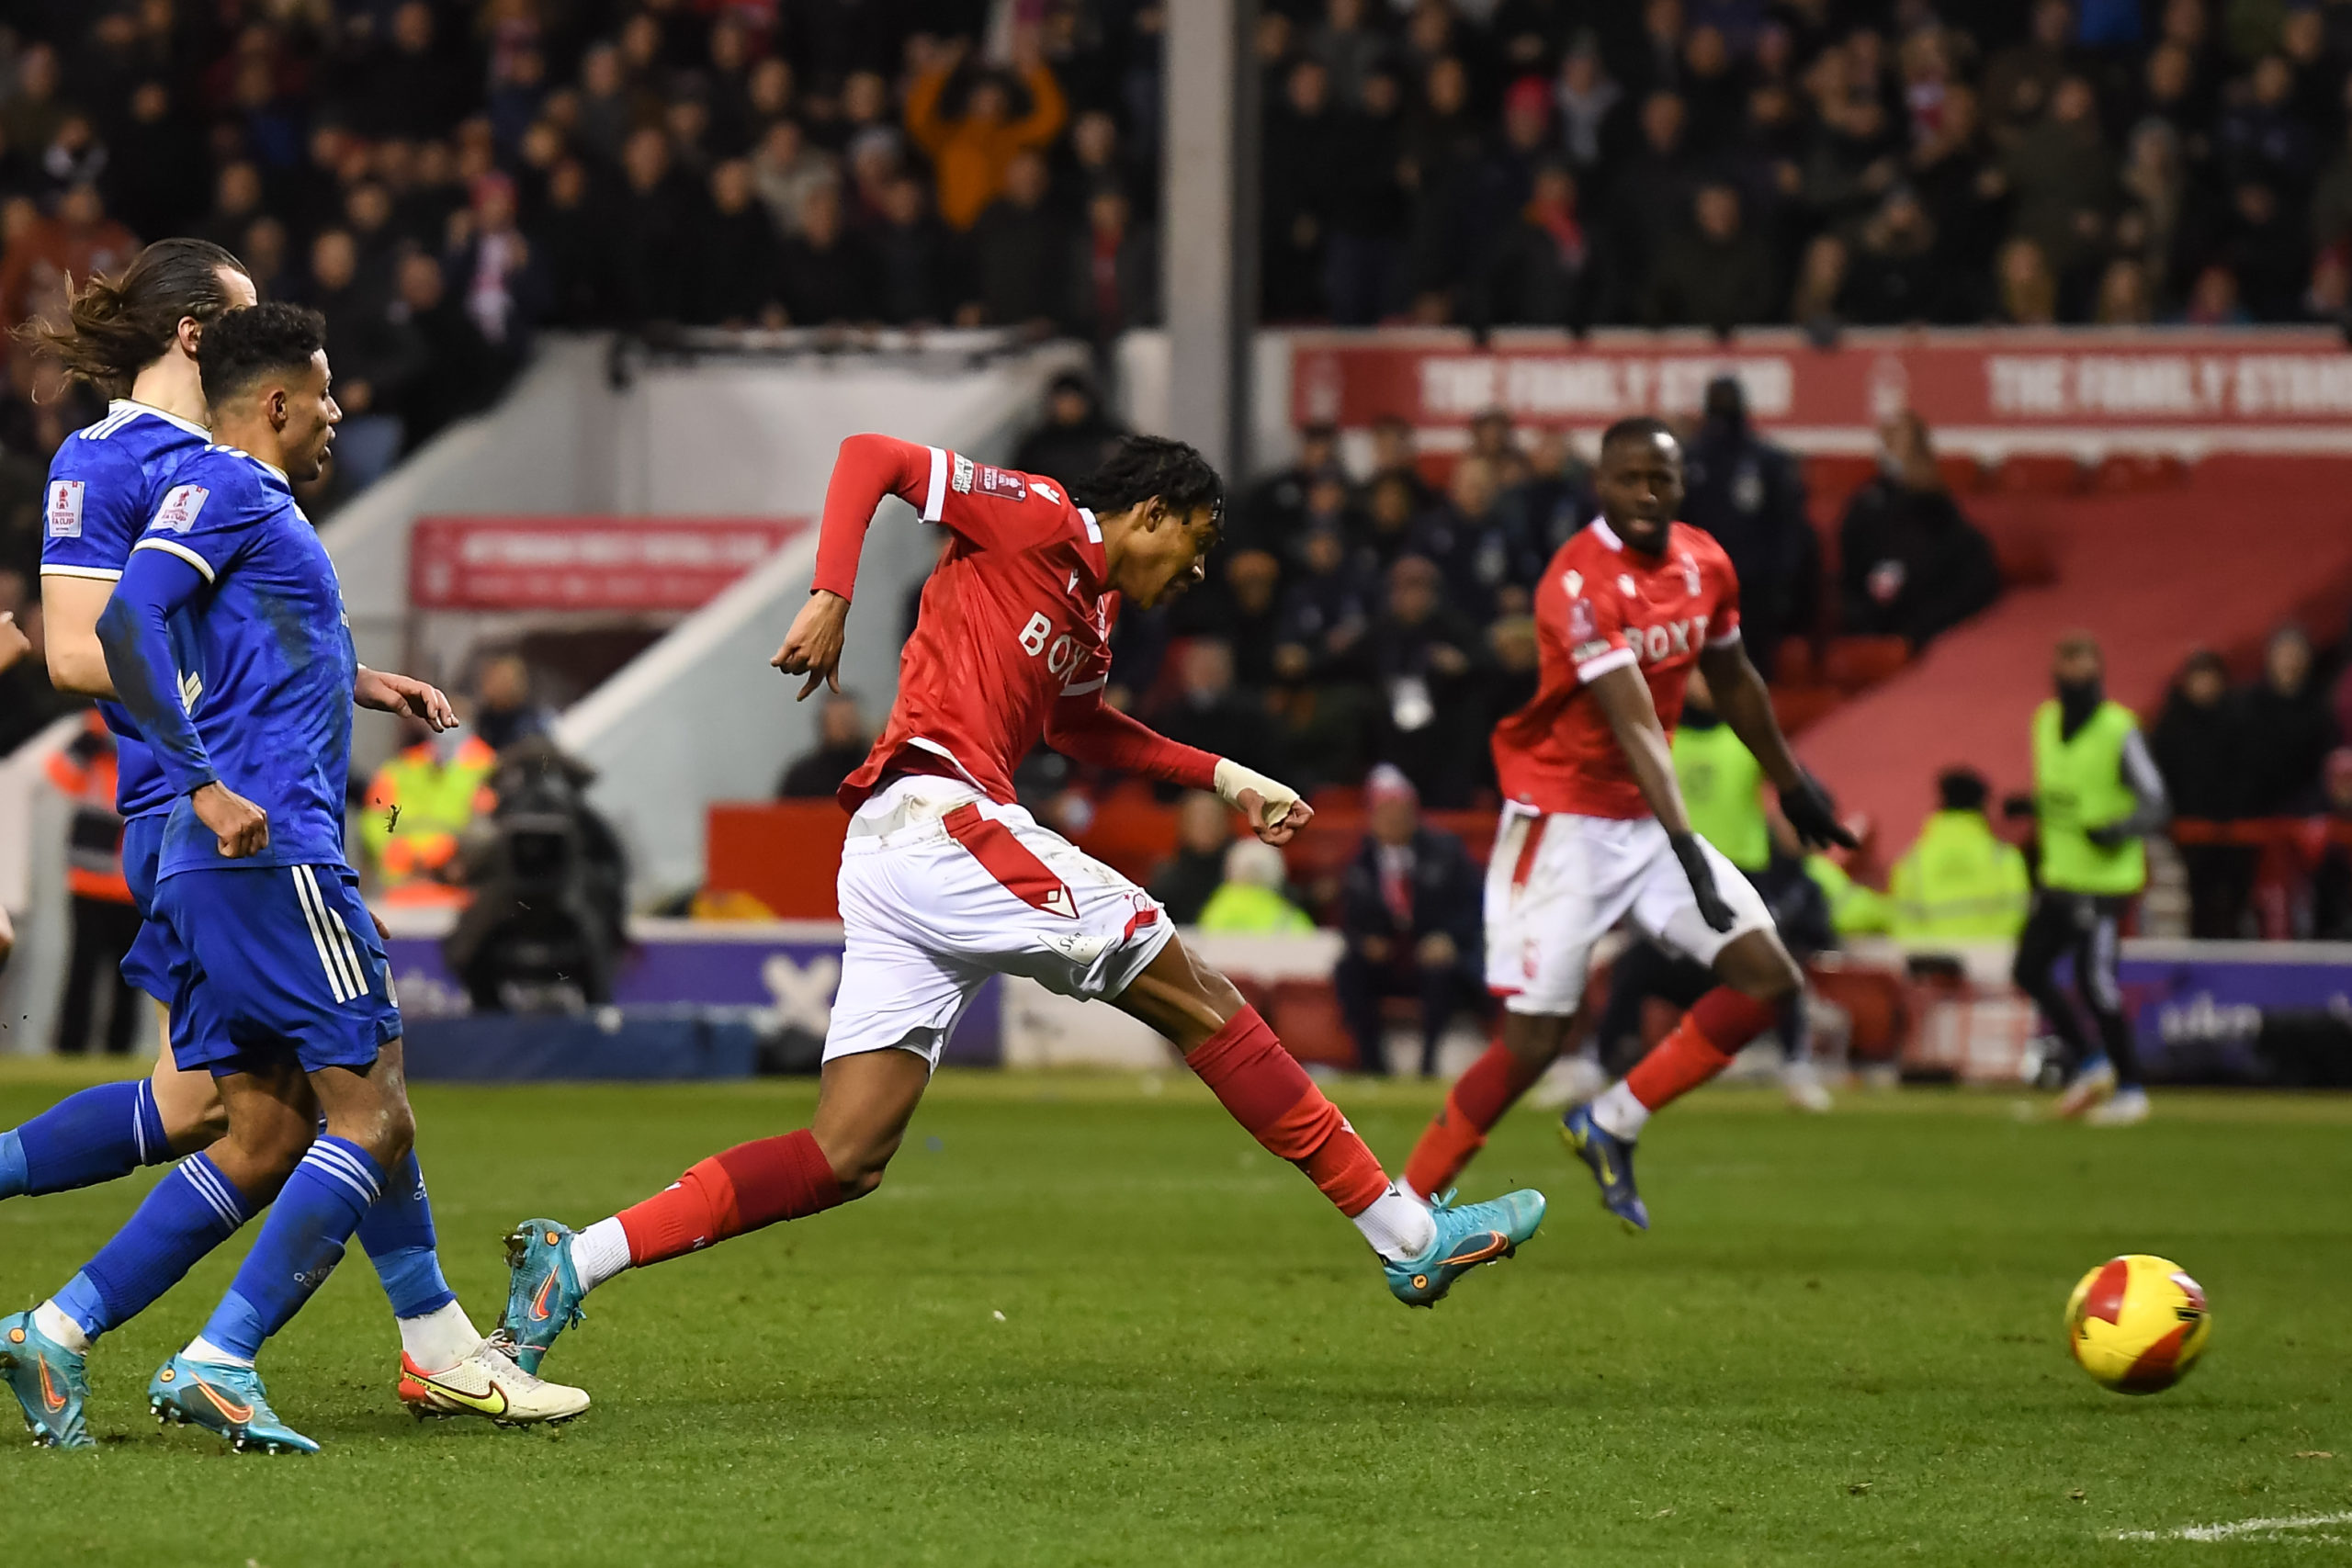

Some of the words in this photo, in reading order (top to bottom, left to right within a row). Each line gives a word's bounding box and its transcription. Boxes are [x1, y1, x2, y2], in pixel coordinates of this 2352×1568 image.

[1420, 357, 1494, 412] THE
[1507, 357, 1653, 412] FAMILY
[1658, 357, 1792, 415] STND
[1989, 355, 2064, 412] THE
[2077, 355, 2233, 412] FAMILY
[1018, 611, 1091, 686] BOX
